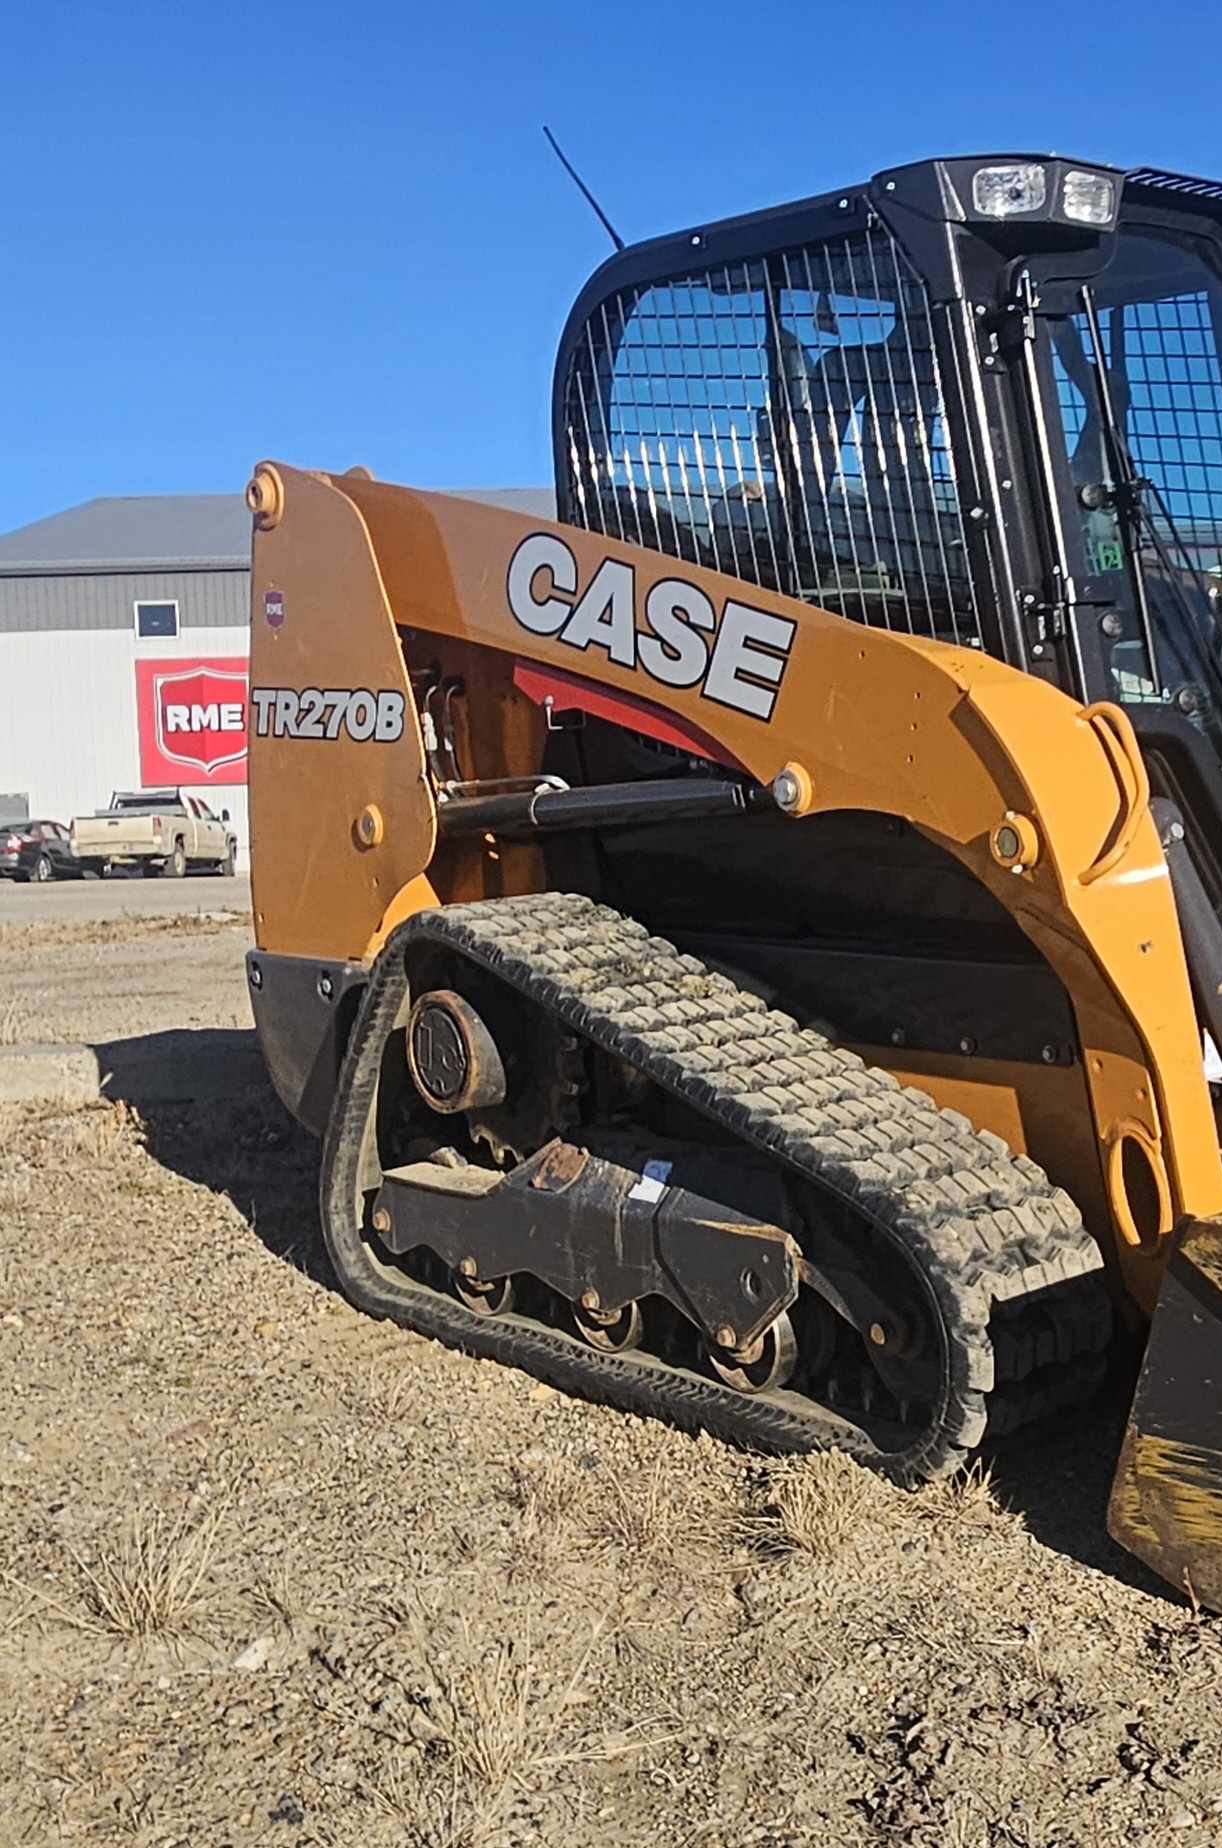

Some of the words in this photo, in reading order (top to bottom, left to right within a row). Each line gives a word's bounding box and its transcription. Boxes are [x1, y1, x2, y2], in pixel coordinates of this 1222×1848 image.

[507, 532, 797, 723] CASE
[166, 703, 244, 732] RME
[251, 687, 405, 742] TR270B
